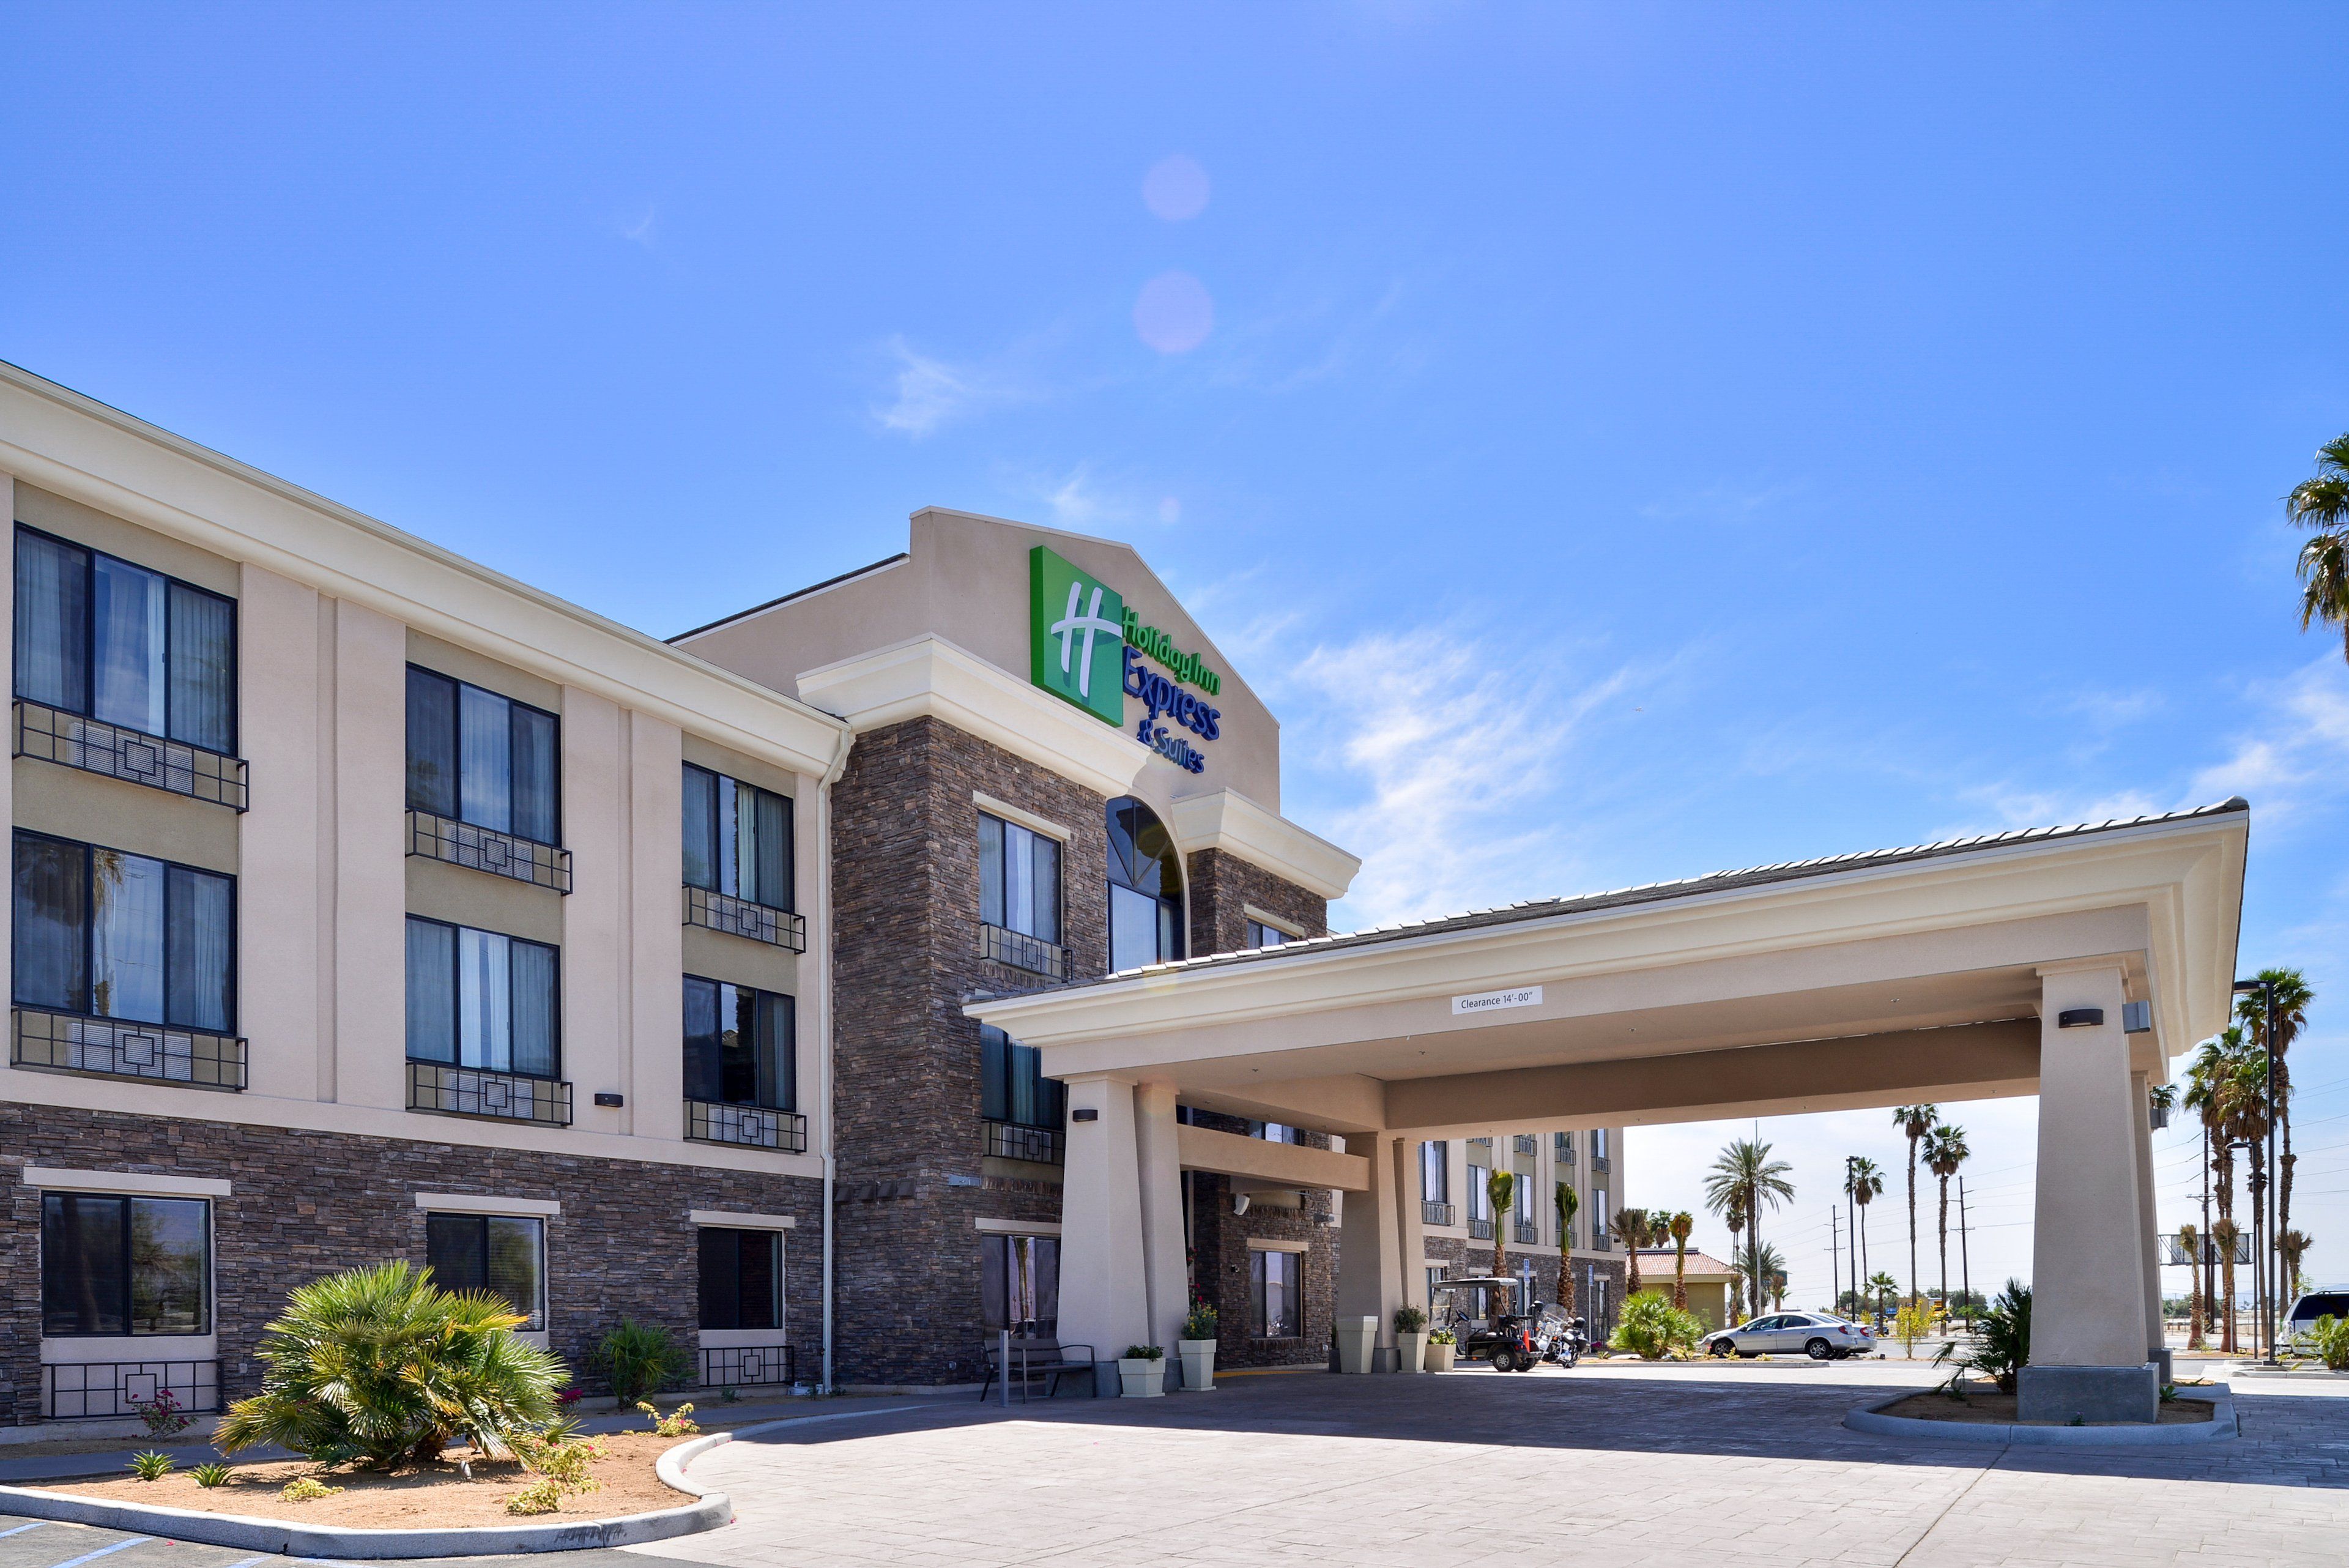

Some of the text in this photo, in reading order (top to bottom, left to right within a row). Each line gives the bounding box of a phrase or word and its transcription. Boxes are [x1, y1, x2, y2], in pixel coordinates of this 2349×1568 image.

[1122, 606, 1221, 696] Holiday Inn
[1123, 645, 1221, 741] Express
[1137, 718, 1205, 774] & Suites
[1461, 991, 1533, 1009] Clearance 14'-00"
